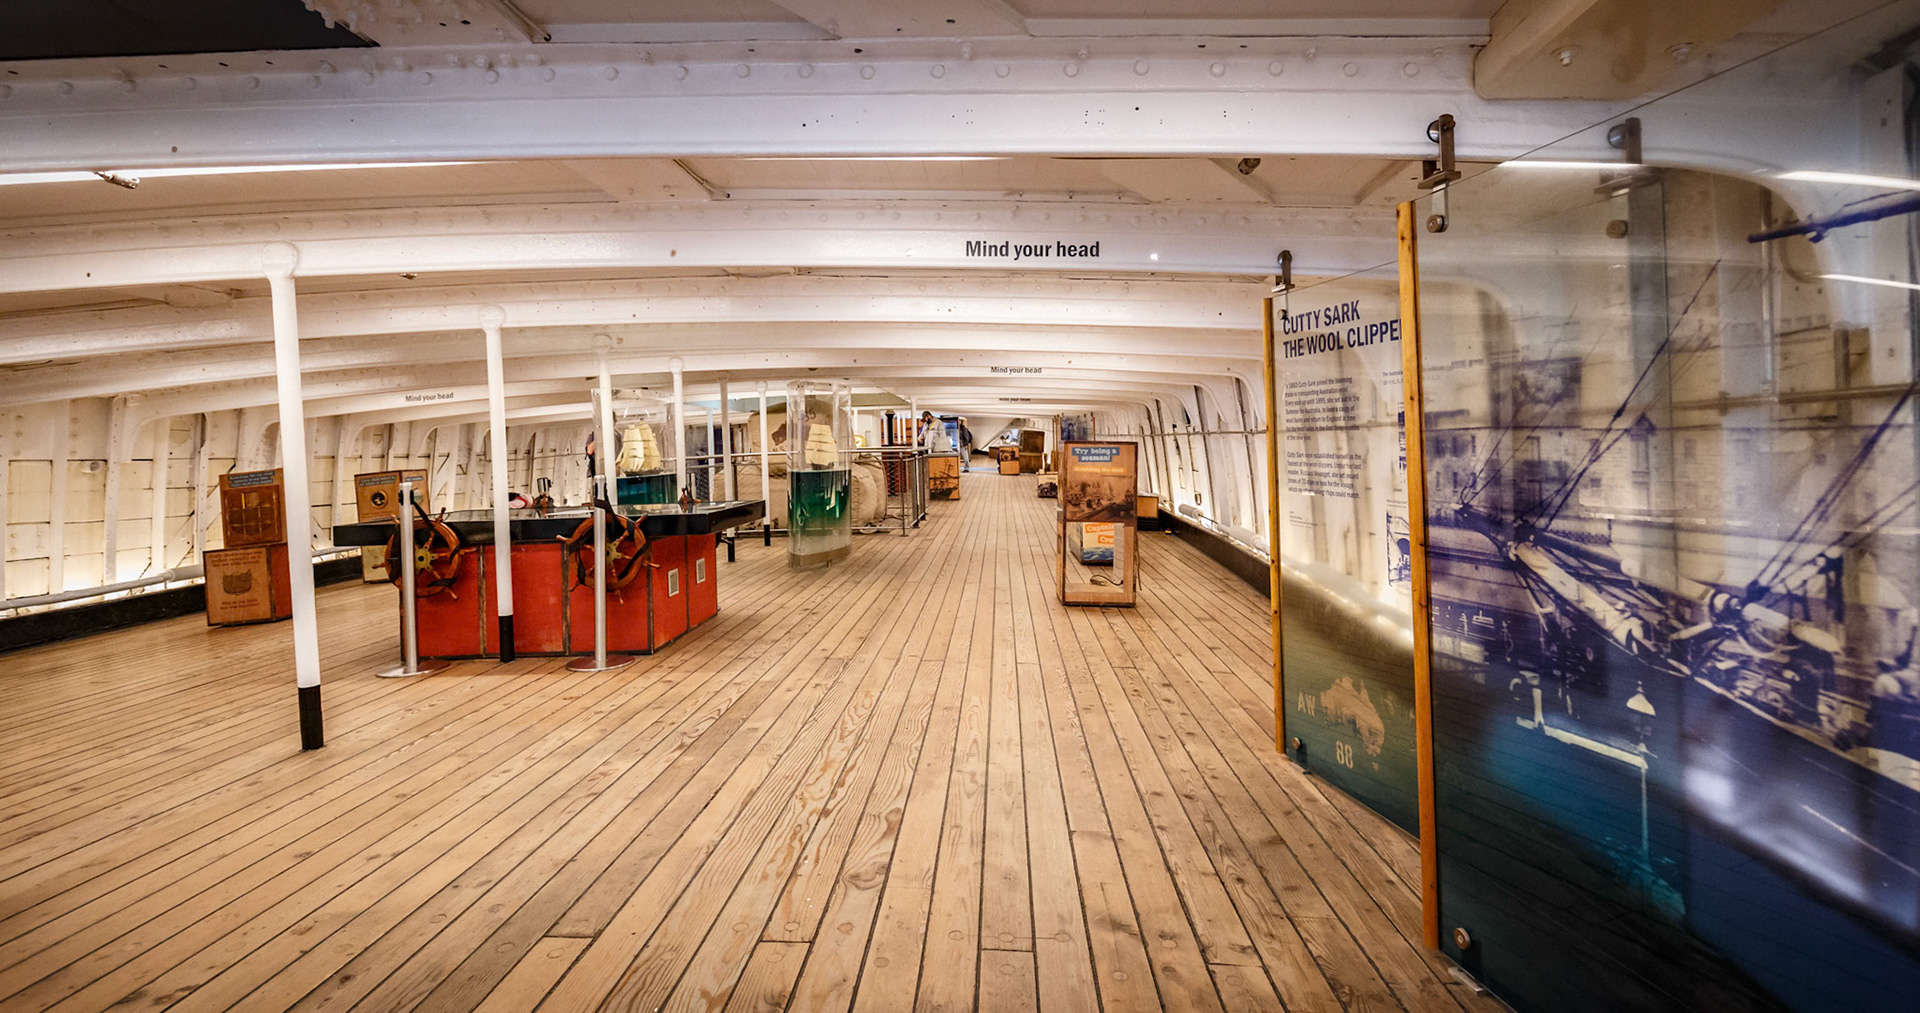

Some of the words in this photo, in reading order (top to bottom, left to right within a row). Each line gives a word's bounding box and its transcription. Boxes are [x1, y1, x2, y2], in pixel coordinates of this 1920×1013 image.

[966, 240, 1009, 257] Mind
[1014, 244, 1052, 260] your
[1056, 240, 1100, 257] head
[1283, 309, 1321, 335] CUTTY
[1324, 300, 1360, 326] SARK
[1283, 338, 1304, 358] THE
[1306, 331, 1344, 354] WOOL
[1348, 318, 1402, 348] CLIPPE
[1298, 692, 1316, 716] AW
[1336, 740, 1353, 768] 88
